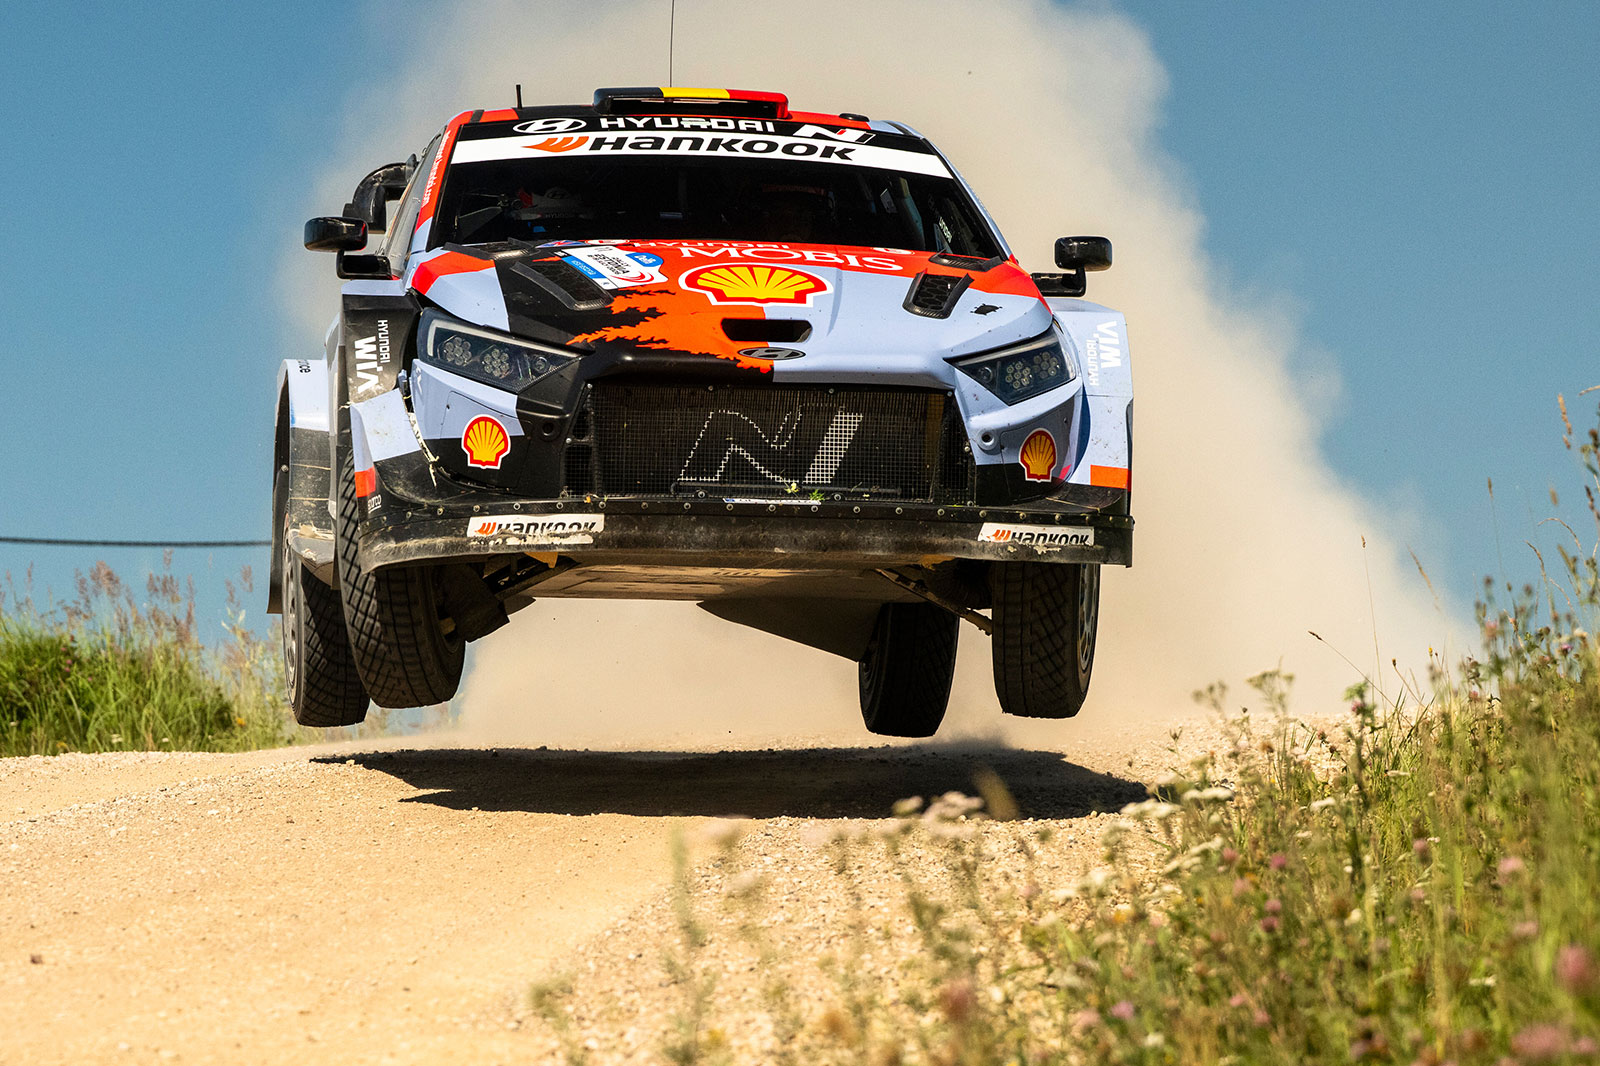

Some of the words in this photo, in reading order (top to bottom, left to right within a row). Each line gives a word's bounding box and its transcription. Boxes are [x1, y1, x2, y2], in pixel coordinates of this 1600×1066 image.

[600, 117, 775, 133] HYUNDAI
[677, 246, 904, 271] MOBIS
[377, 320, 391, 364] HYUNDAI
[1086, 339, 1100, 386] HYUNDAI
